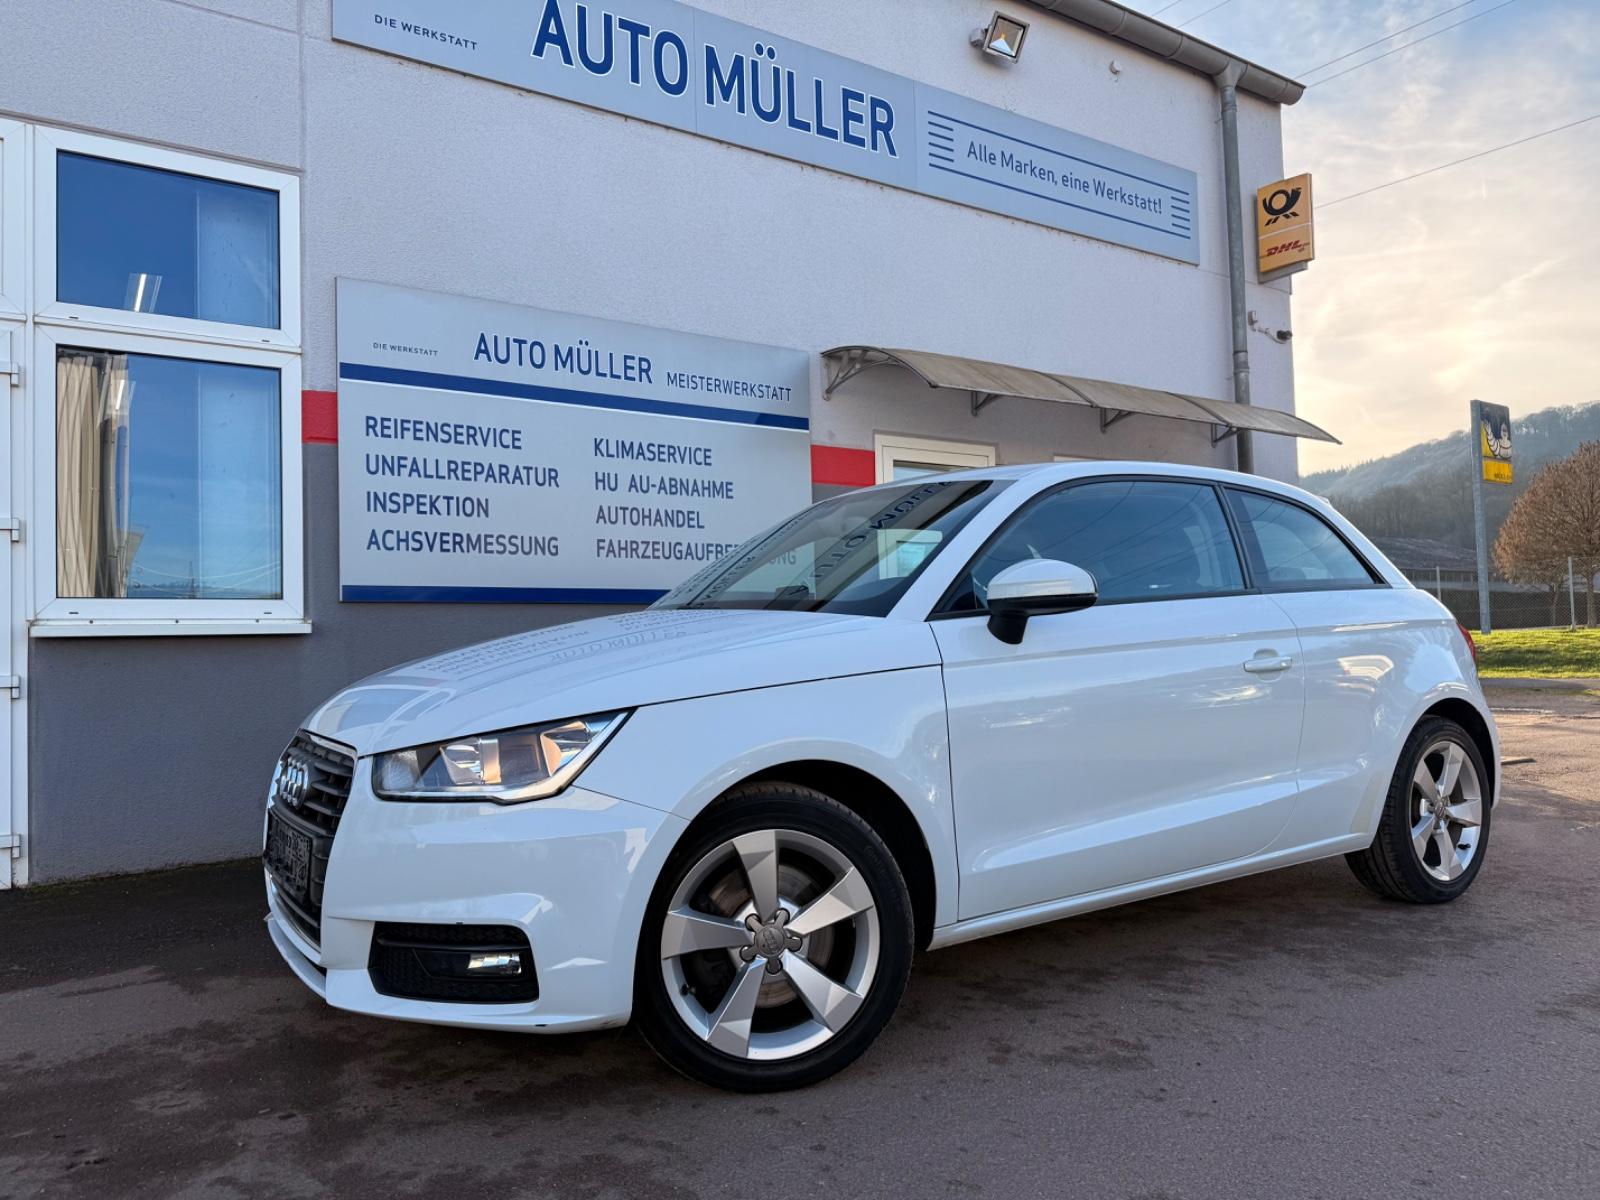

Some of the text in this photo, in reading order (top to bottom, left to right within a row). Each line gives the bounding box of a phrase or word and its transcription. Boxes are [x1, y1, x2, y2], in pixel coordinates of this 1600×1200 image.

[374, 14, 477, 51] DIE WERKSTATT
[531, 0, 899, 159] AUTO MÜLLER
[967, 141, 1163, 215] Alle Marken, eine Werkstatt!
[1265, 240, 1303, 257] DHL
[372, 341, 438, 357] DIE WERKSTATT
[473, 332, 652, 384] AUTO MÜLLER
[667, 371, 792, 402] MEISTERWERKSTATT
[366, 416, 522, 450] REIFENSERVICE
[594, 438, 713, 467] KLIMASERVICE
[366, 454, 559, 488] UNFALLREPARATUR
[594, 472, 734, 500] HU AU-ABNAHME
[366, 491, 490, 519] INSPEKTION
[595, 505, 705, 530] AUTOHANDEL
[366, 529, 559, 558] ACHSVERMESSUNG
